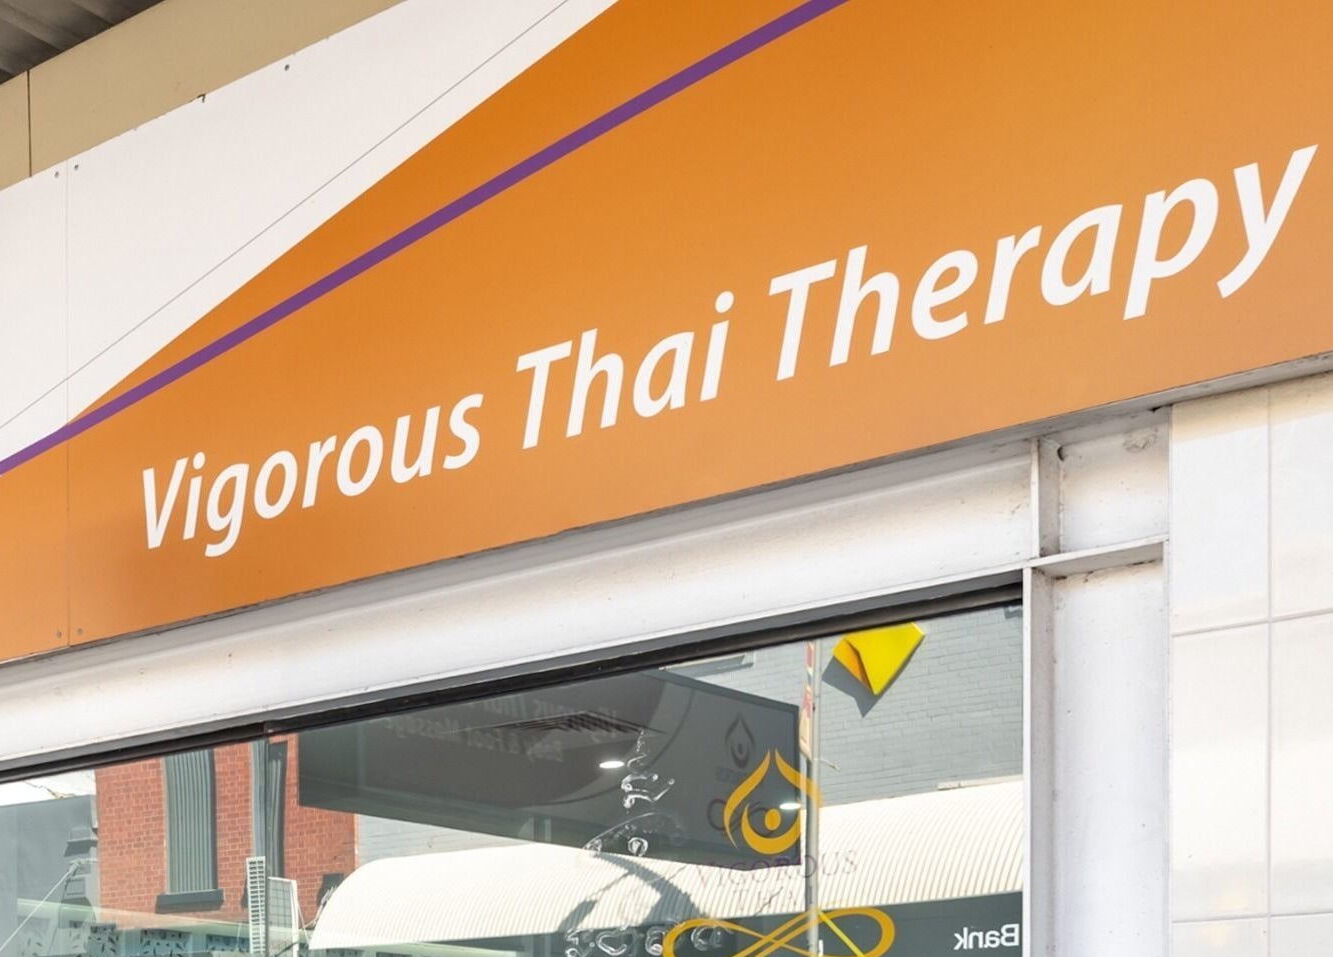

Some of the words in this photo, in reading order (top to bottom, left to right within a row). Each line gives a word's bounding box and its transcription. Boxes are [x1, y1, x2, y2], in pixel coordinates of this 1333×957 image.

[141, 394, 482, 558] Vigorous
[516, 291, 737, 451] Thai
[767, 144, 1319, 383] Therapy
